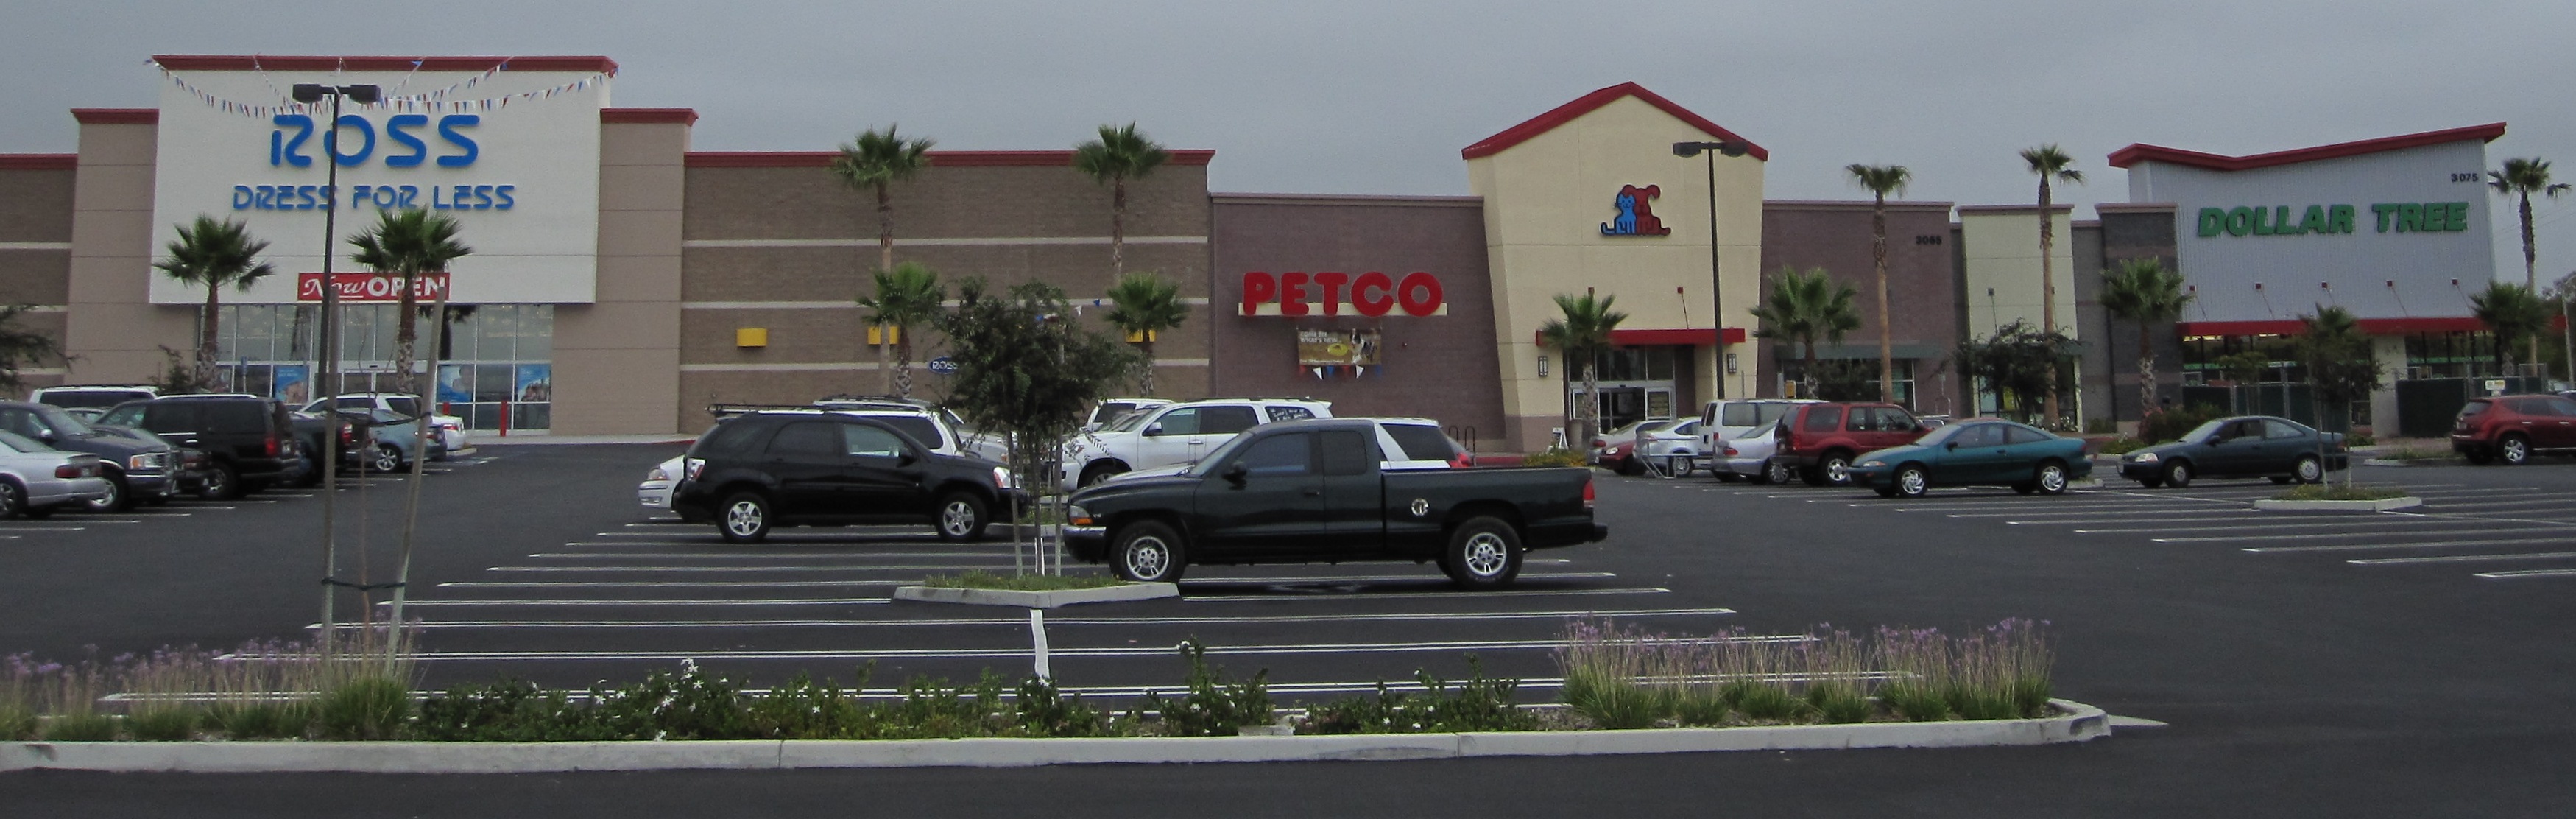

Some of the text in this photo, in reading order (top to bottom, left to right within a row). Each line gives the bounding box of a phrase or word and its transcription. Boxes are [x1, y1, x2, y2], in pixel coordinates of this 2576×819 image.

[270, 114, 480, 167] ROSS
[2451, 173, 2478, 182] 3075
[233, 185, 515, 210] DRESS FOR LESS
[2199, 202, 2469, 236] DOLLAR TREE
[1243, 271, 1443, 317] PETCO
